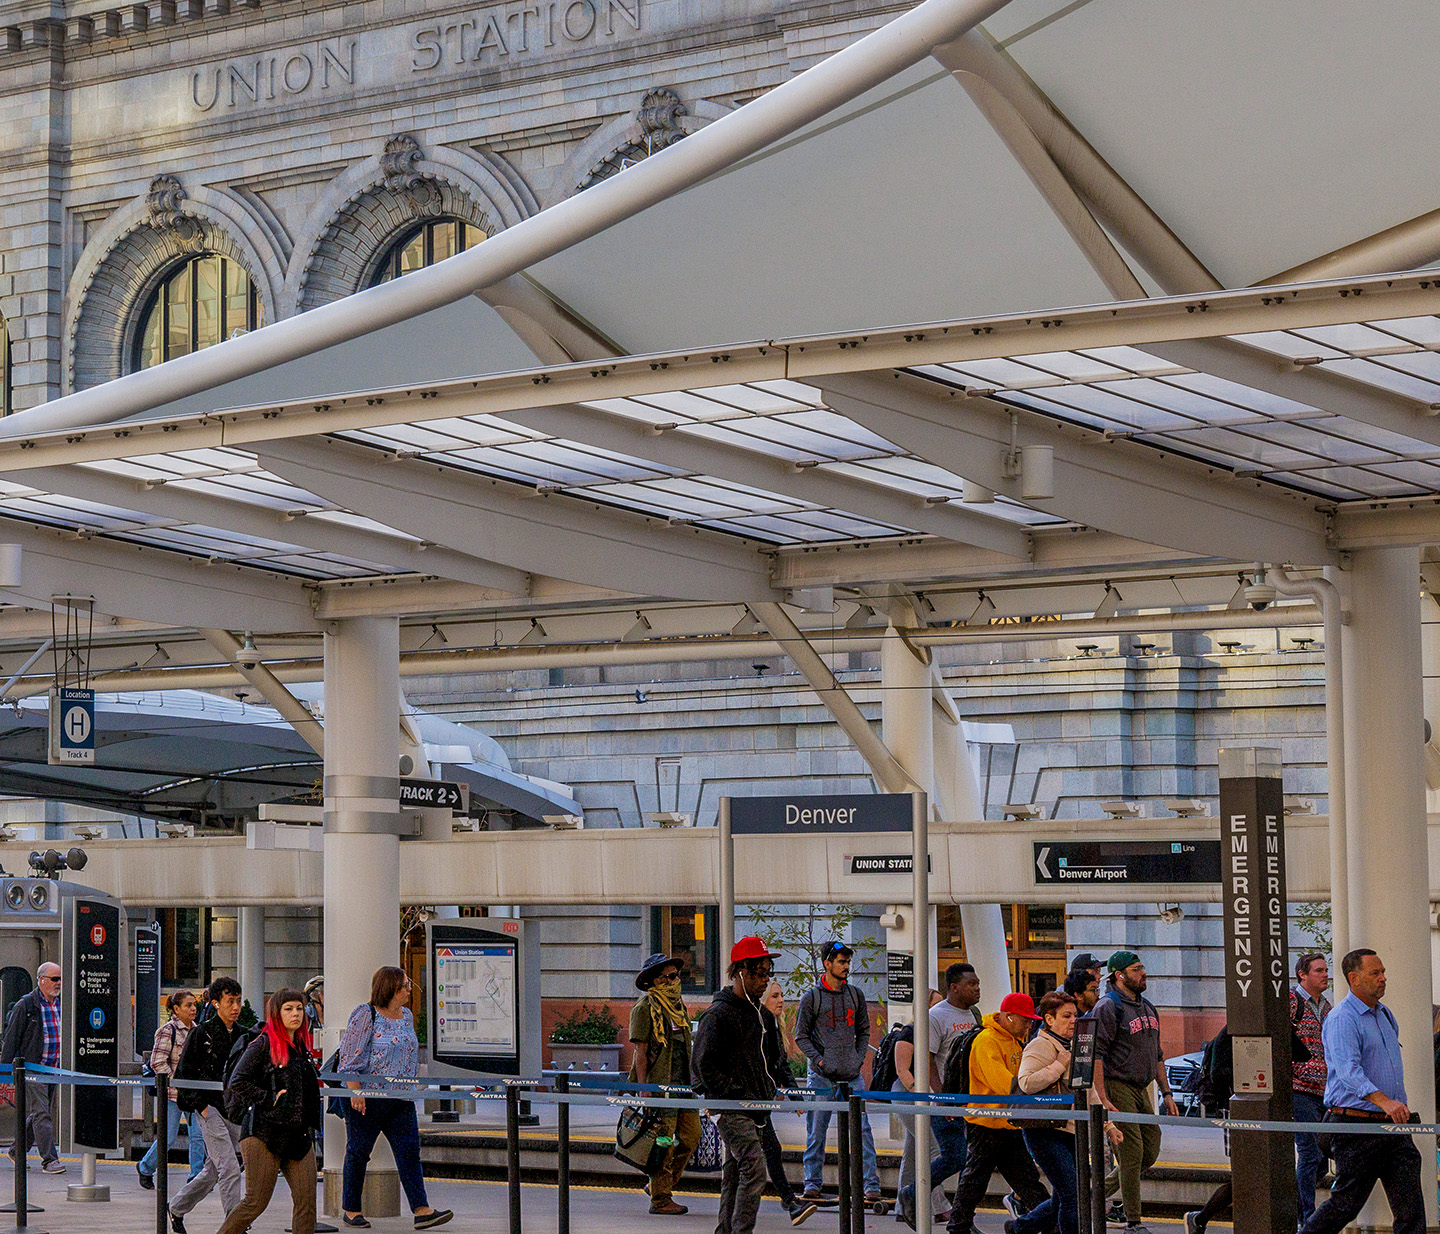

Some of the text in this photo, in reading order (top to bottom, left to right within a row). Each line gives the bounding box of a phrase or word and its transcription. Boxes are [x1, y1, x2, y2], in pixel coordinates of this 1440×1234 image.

[191, 0, 643, 113] UNION STATION
[65, 690, 91, 699] Location
[70, 712, 84, 736] H
[67, 750, 82, 758] Track
[400, 786, 447, 804] TRACK 2
[785, 804, 857, 825] Denver
[856, 859, 886, 869] UNION
[1059, 869, 1128, 880] Denver Airport
[1230, 814, 1252, 998] EMERGENCY
[1265, 815, 1283, 998] EMERGENCY
